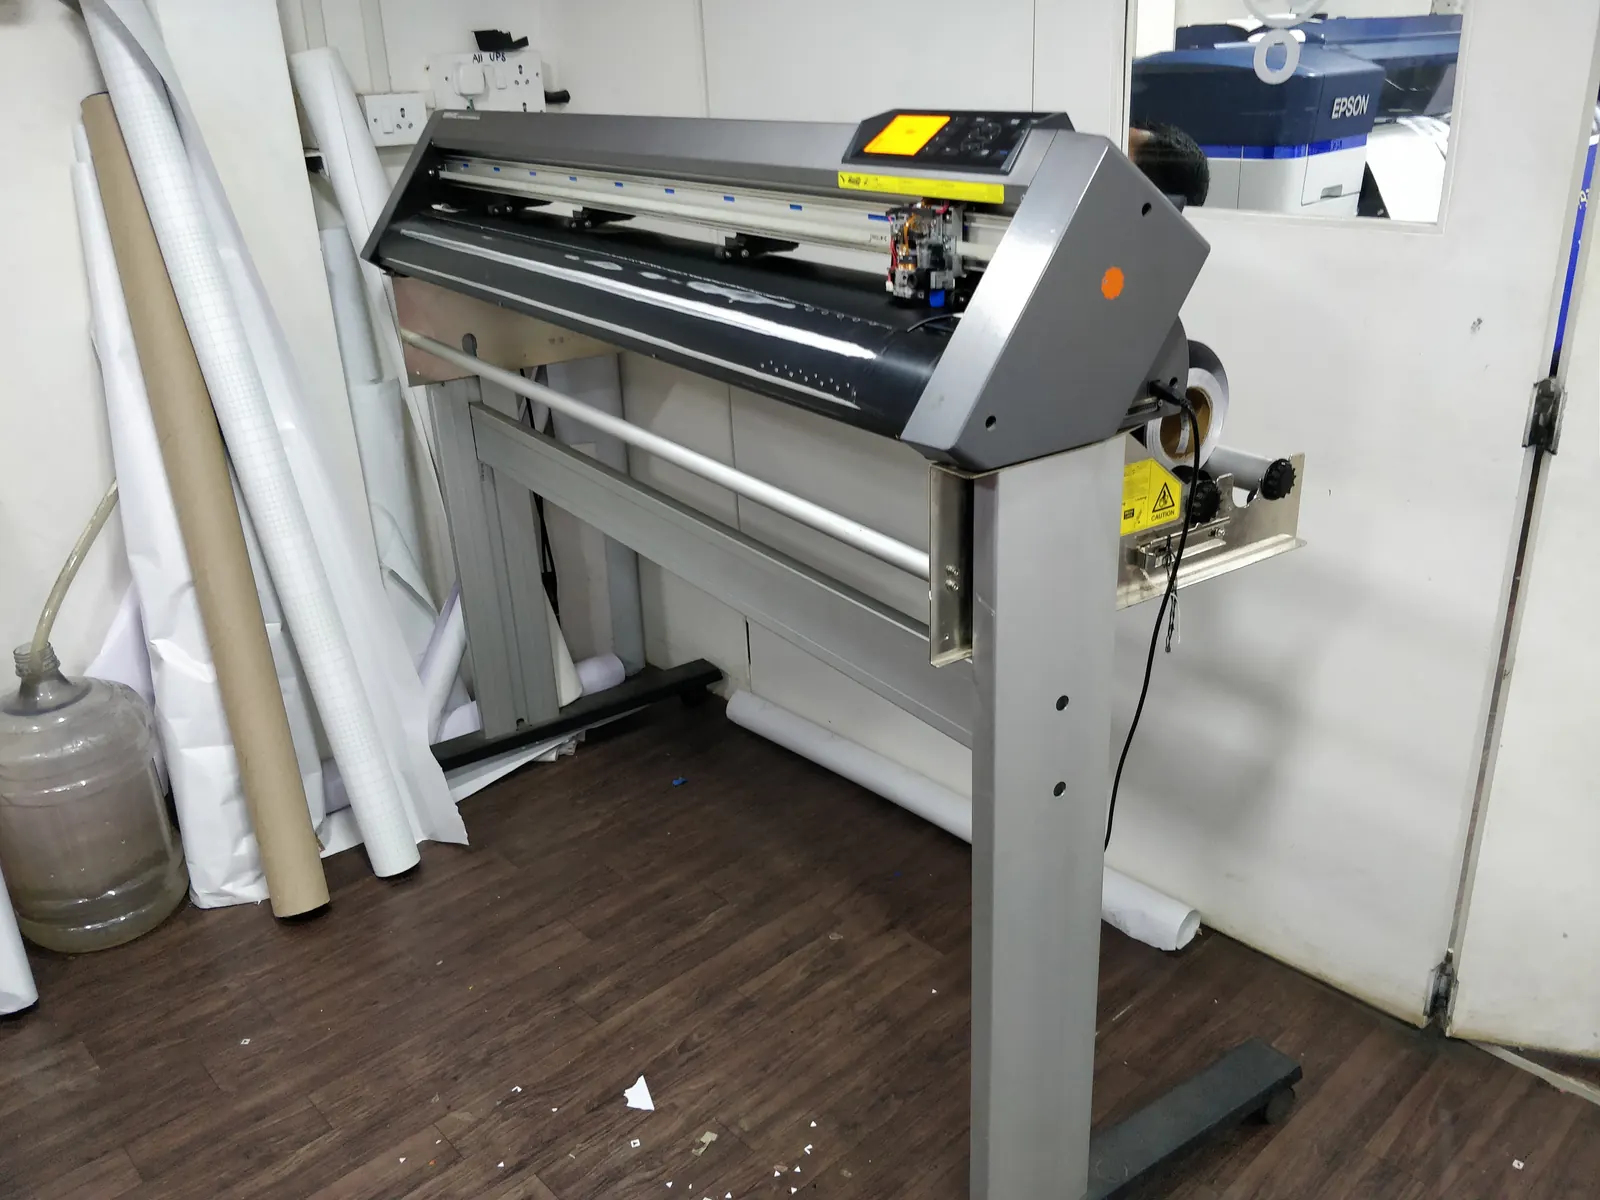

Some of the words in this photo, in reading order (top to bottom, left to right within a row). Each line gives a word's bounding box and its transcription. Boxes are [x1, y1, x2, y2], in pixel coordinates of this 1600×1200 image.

[489, 51, 507, 62] UPS
[1331, 93, 1370, 119] EPSON
[1150, 509, 1175, 522] CAUTION
